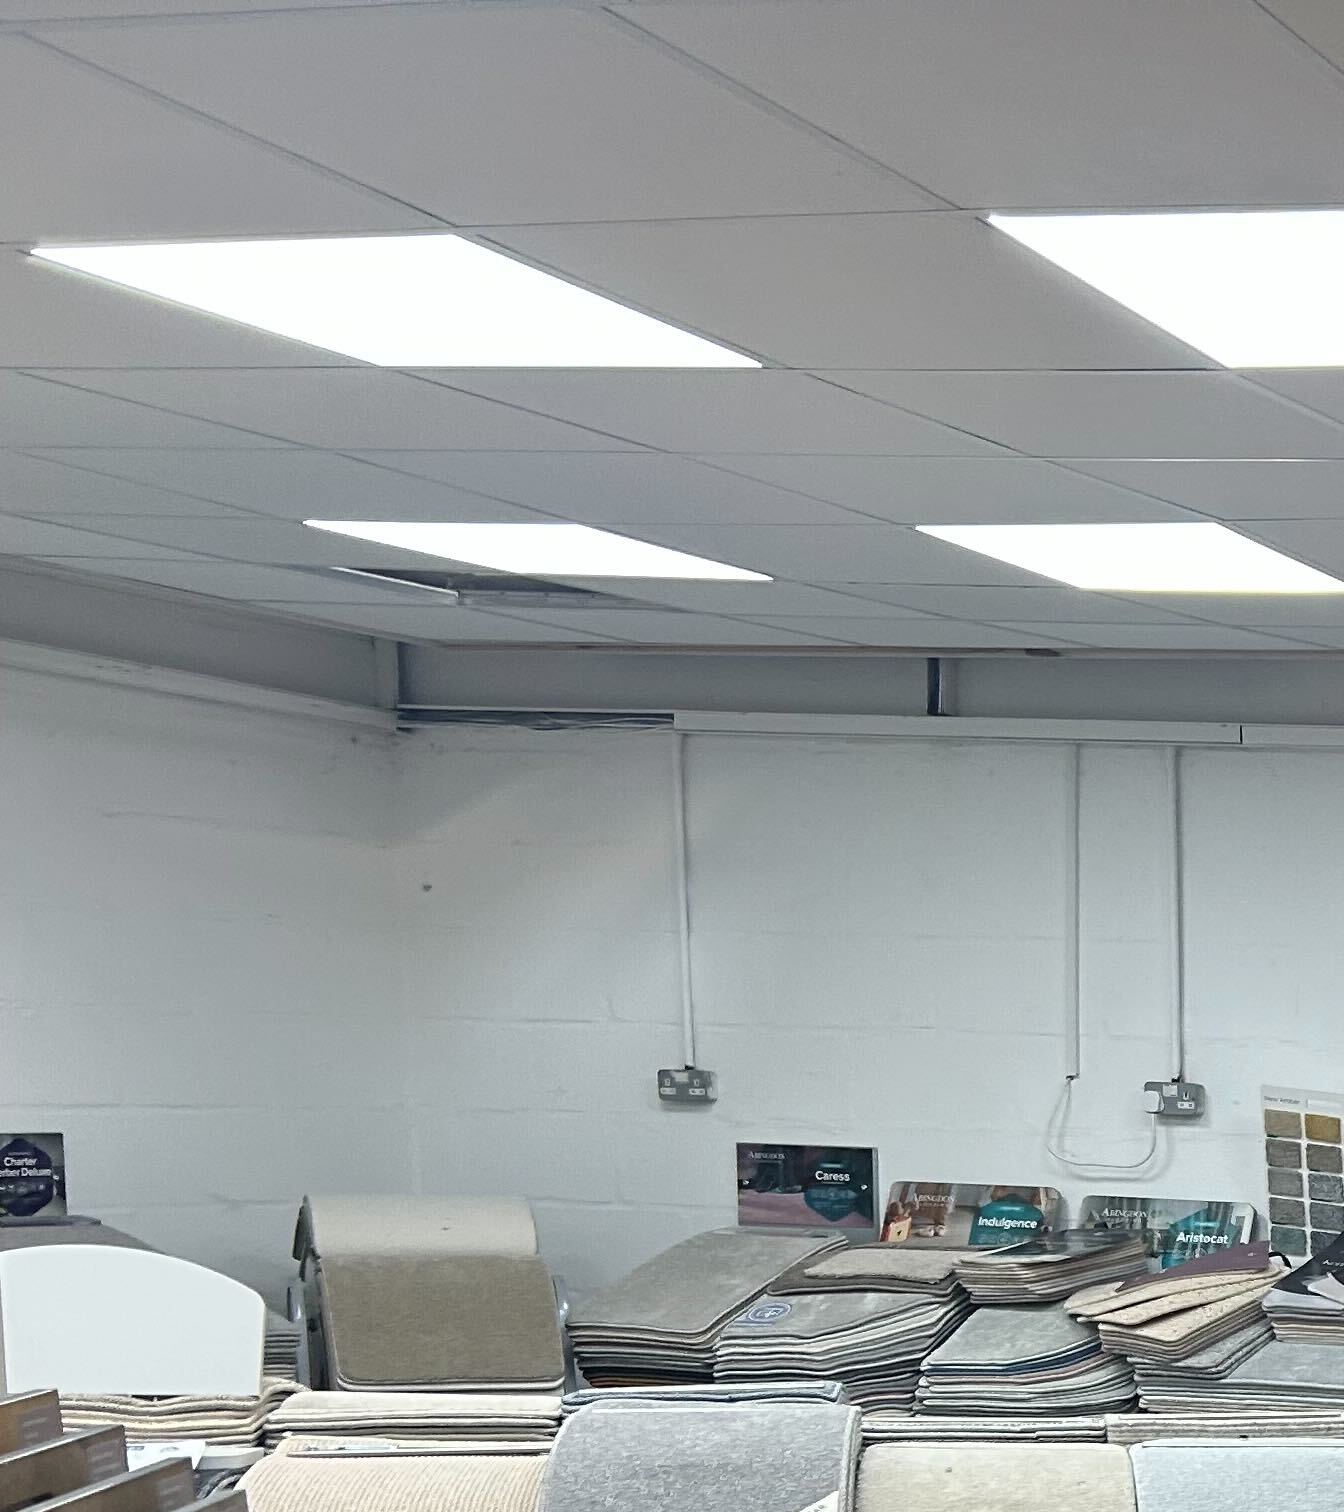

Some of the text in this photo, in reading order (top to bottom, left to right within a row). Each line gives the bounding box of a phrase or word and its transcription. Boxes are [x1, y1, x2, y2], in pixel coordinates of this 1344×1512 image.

[3, 1156, 37, 1167] Charter
[815, 1170, 851, 1182] Caress
[977, 1215, 1038, 1230] Indulgence
[1176, 1231, 1229, 1245] Aristocat
